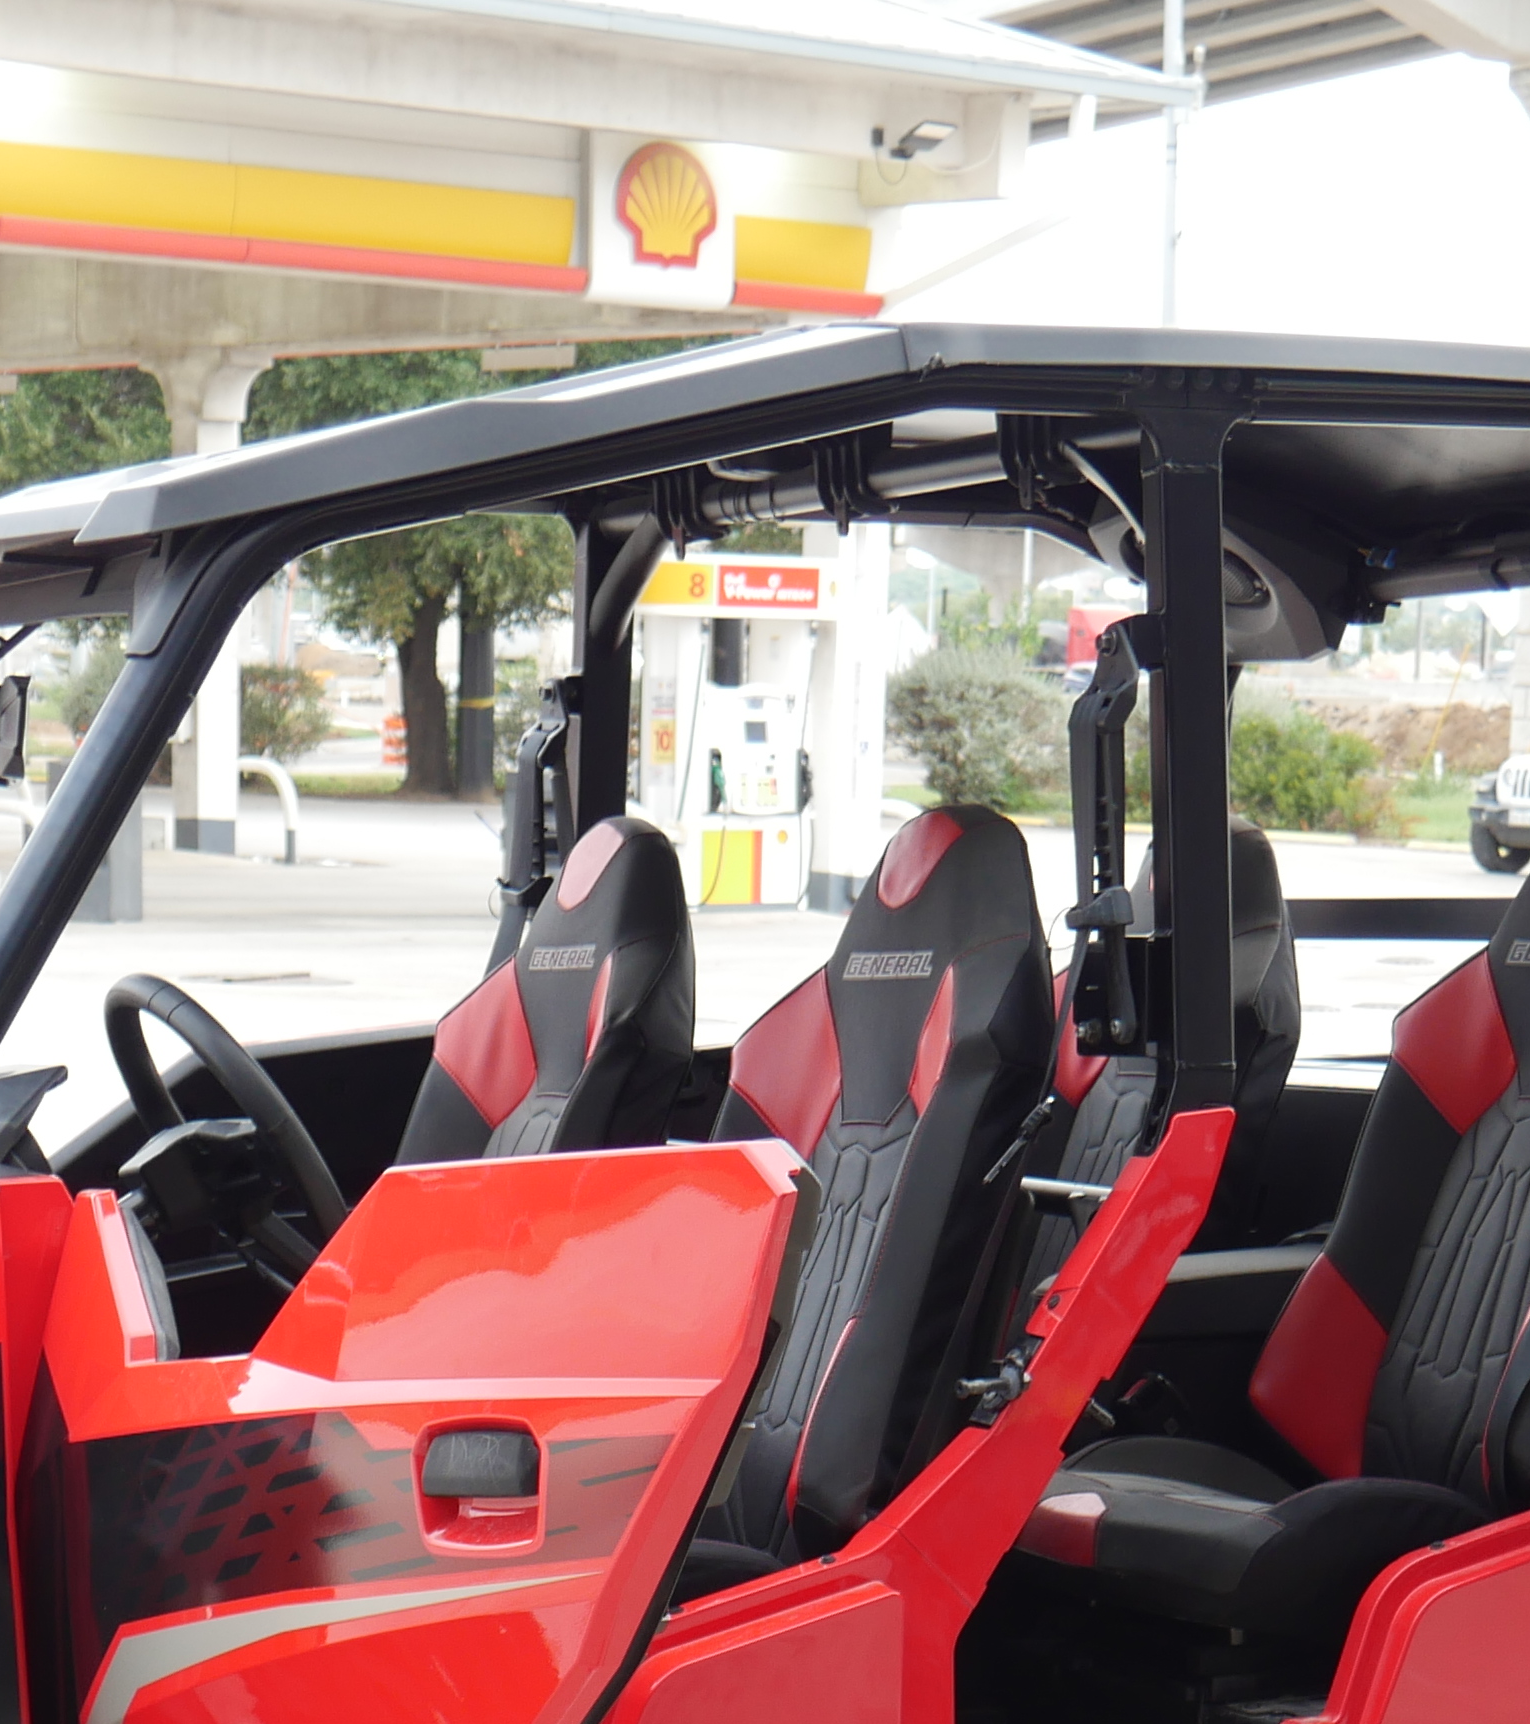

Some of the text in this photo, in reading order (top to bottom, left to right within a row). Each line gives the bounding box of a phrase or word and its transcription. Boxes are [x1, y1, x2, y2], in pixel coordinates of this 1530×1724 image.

[689, 572, 706, 599] 8
[528, 944, 596, 971] GENERAL
[842, 949, 934, 981] GENERAL
